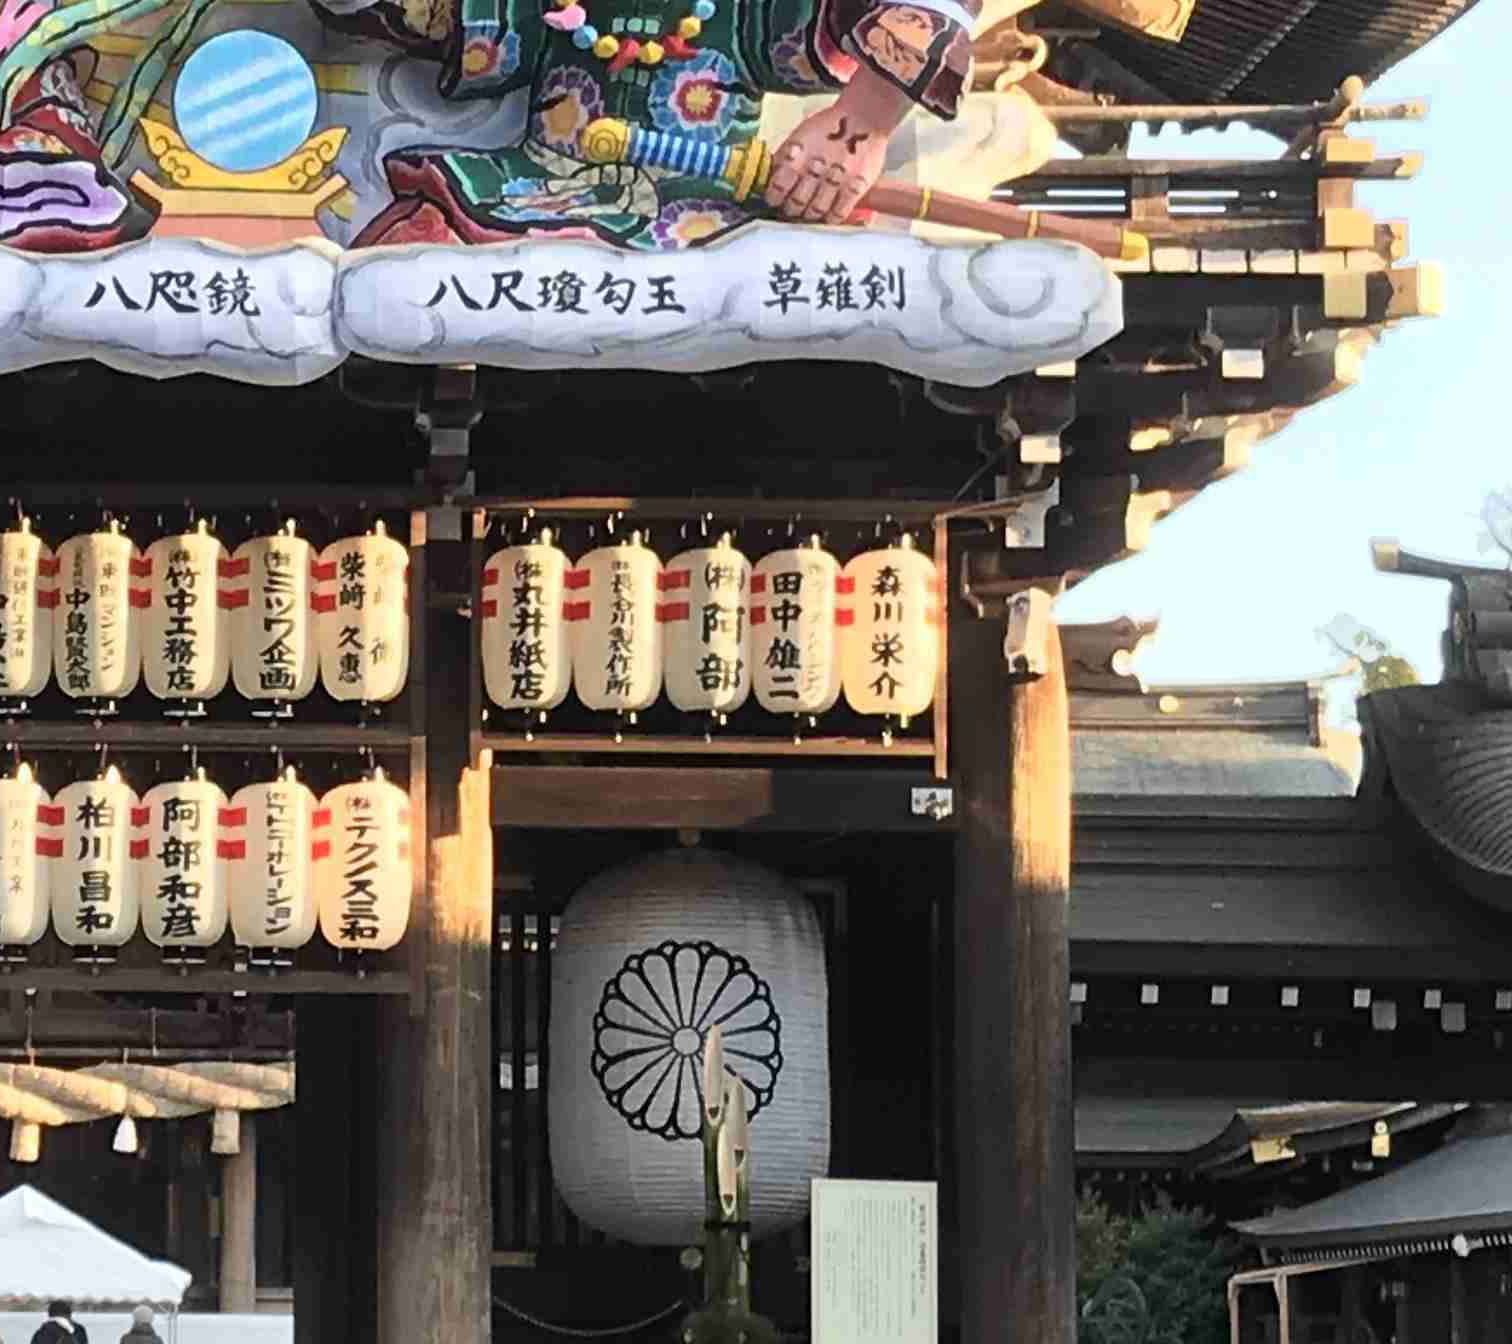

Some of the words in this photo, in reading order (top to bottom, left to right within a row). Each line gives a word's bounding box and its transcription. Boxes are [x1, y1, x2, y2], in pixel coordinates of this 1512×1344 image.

[84, 267, 261, 317] 八咫鏡
[763, 261, 907, 316] 草薙剣
[762, 570, 804, 700] 田中雄二
[866, 565, 905, 701] 森川栄介
[155, 795, 203, 938] 阿部和彦
